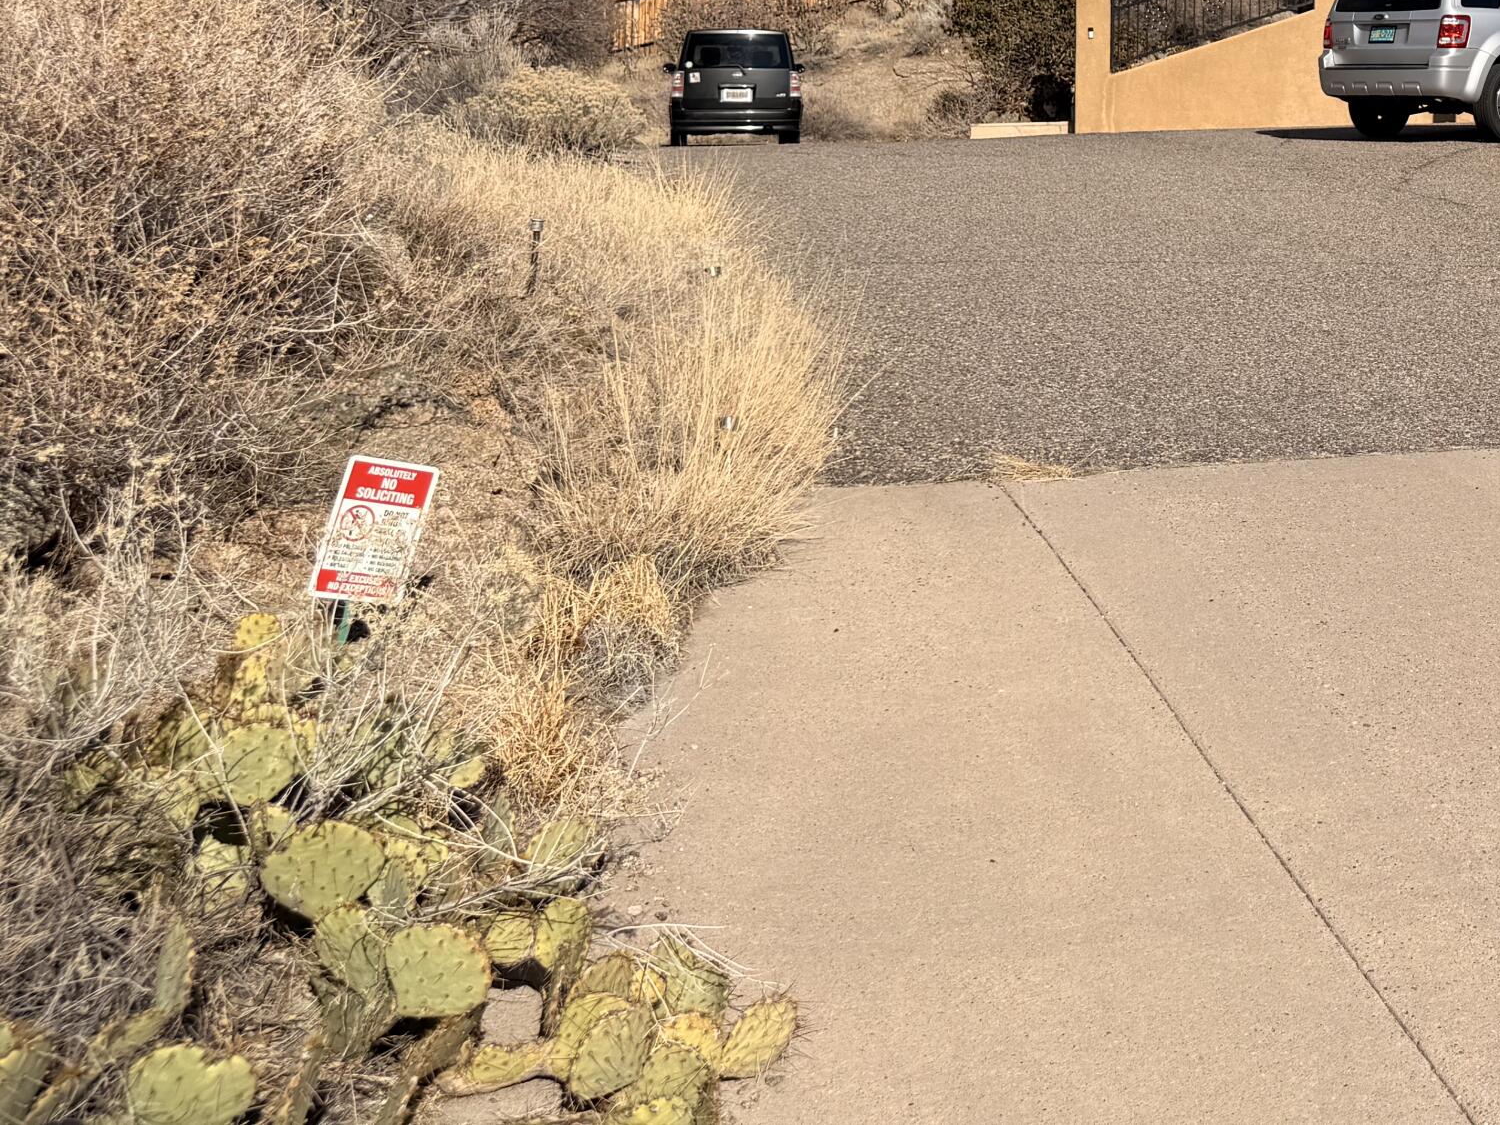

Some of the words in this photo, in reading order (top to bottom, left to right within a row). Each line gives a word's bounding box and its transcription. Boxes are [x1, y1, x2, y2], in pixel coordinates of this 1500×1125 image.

[368, 466, 417, 480] ABSOLUTELY
[380, 478, 397, 490] NO
[356, 487, 414, 505] SOLICITING
[327, 582, 339, 590] NO
